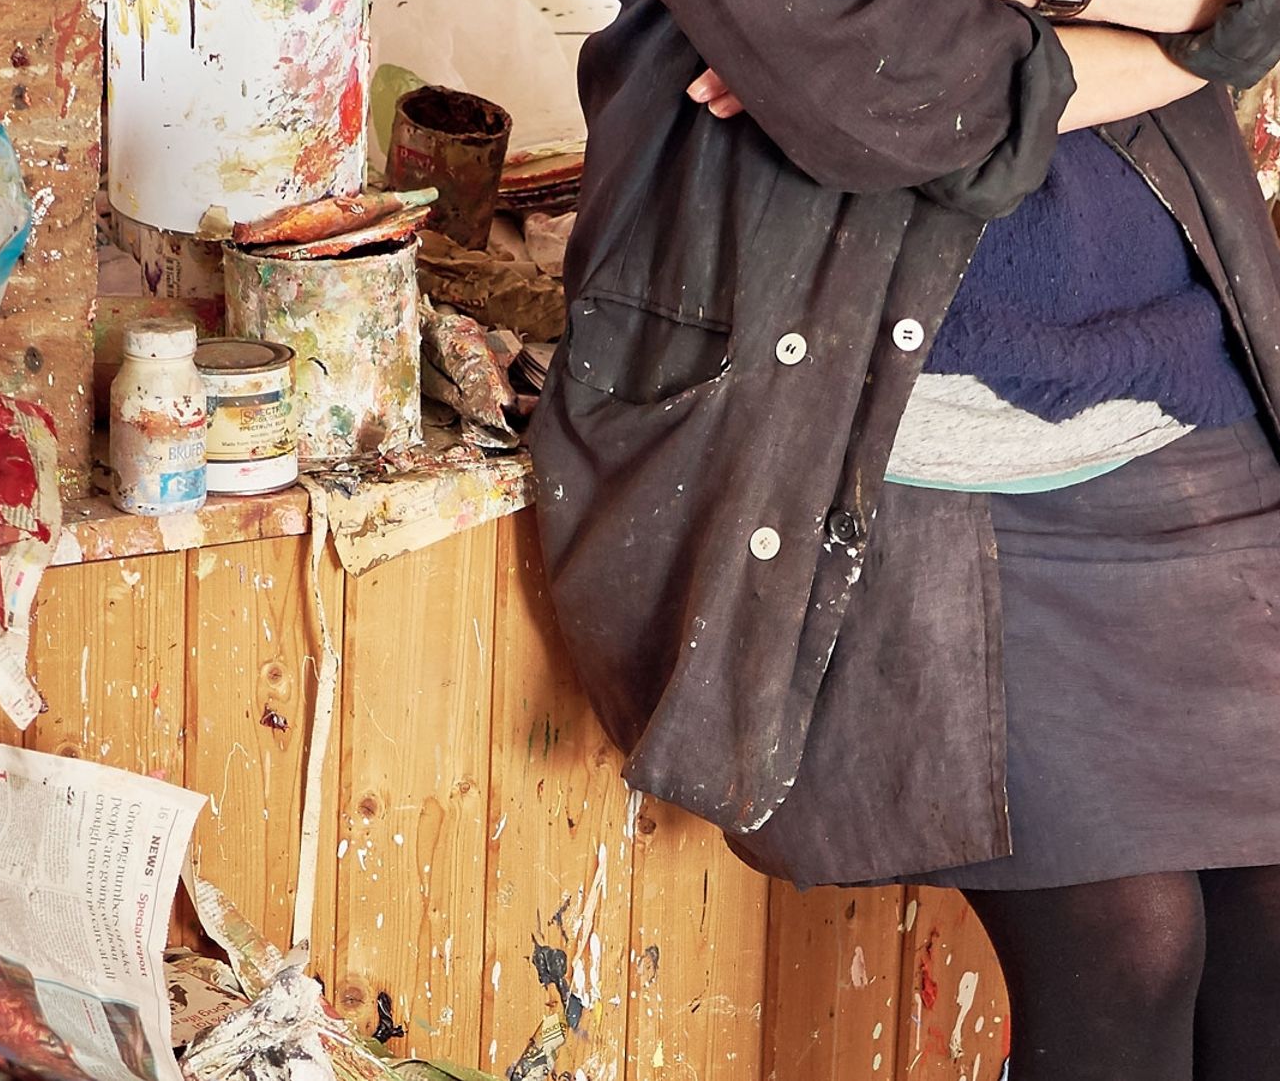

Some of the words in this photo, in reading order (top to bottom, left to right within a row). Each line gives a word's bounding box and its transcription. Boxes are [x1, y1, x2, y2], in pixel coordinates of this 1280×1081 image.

[90, 794, 106, 845] enough
[106, 797, 122, 844] people
[159, 805, 170, 819] 16
[87, 849, 96, 878] care
[145, 835, 161, 877] NEWS
[97, 871, 109, 909] going
[113, 864, 130, 928] numbers
[134, 892, 149, 937] Special
[135, 941, 150, 977] report
